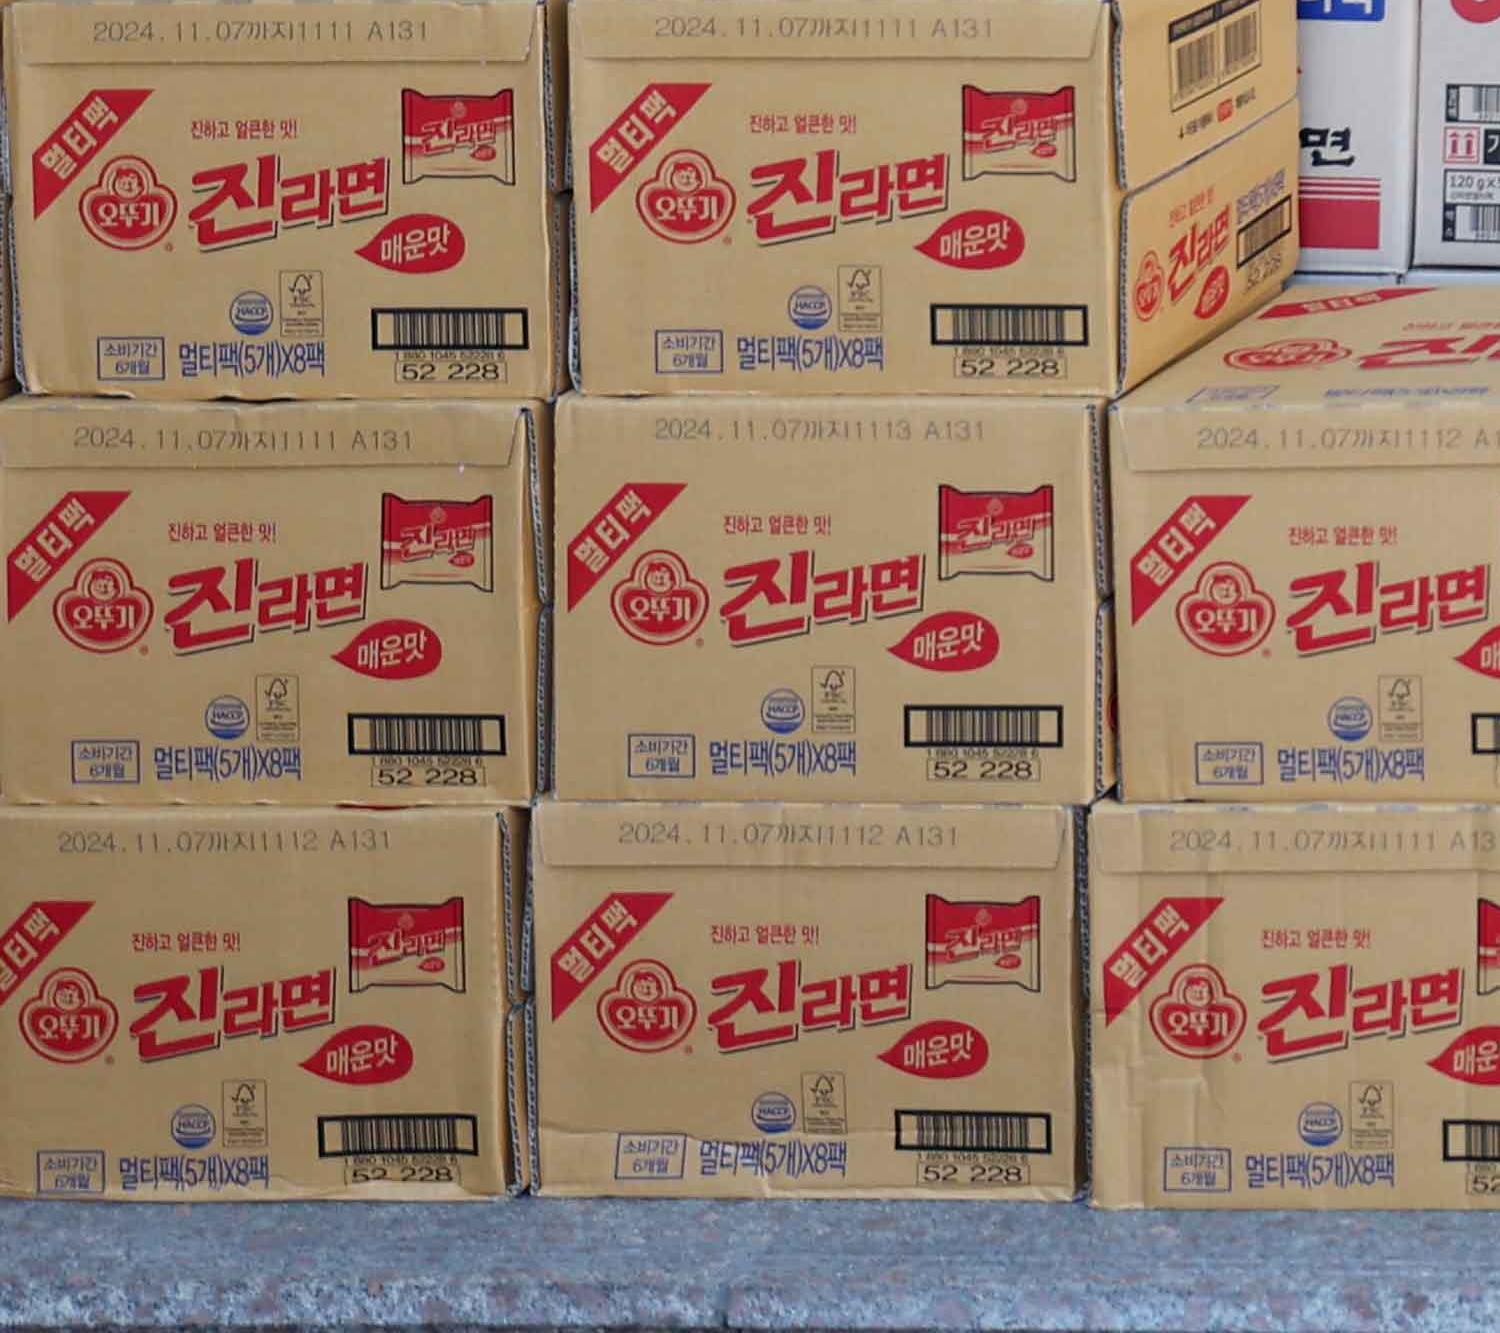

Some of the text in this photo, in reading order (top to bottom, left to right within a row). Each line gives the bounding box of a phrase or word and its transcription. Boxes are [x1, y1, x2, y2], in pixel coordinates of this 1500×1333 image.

[367, 21, 428, 42] A131
[39, 97, 119, 181] 멀티팩
[191, 119, 298, 140] 진하고 얼큰한 맛!
[188, 154, 390, 254] 진라면
[97, 202, 161, 229] 오뚜기
[380, 226, 452, 265] 매운맛
[104, 341, 158, 359] 소비기간
[115, 359, 151, 376] 6개월
[402, 362, 500, 382] 52 228
